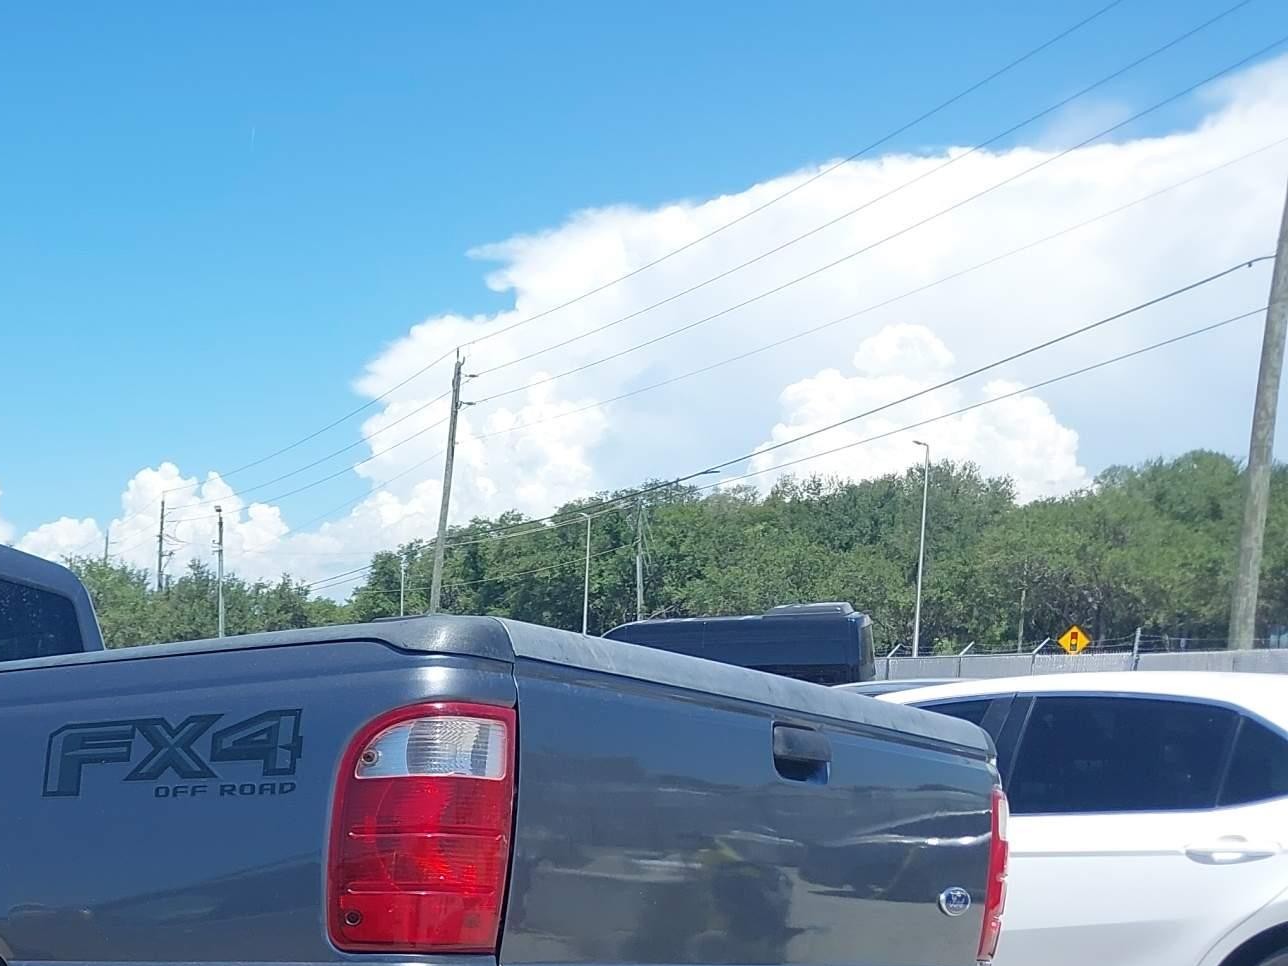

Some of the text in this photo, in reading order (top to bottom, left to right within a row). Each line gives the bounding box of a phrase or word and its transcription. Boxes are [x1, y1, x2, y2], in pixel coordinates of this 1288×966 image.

[42, 708, 304, 797] FX4
[154, 781, 297, 798] OFF ROAD
